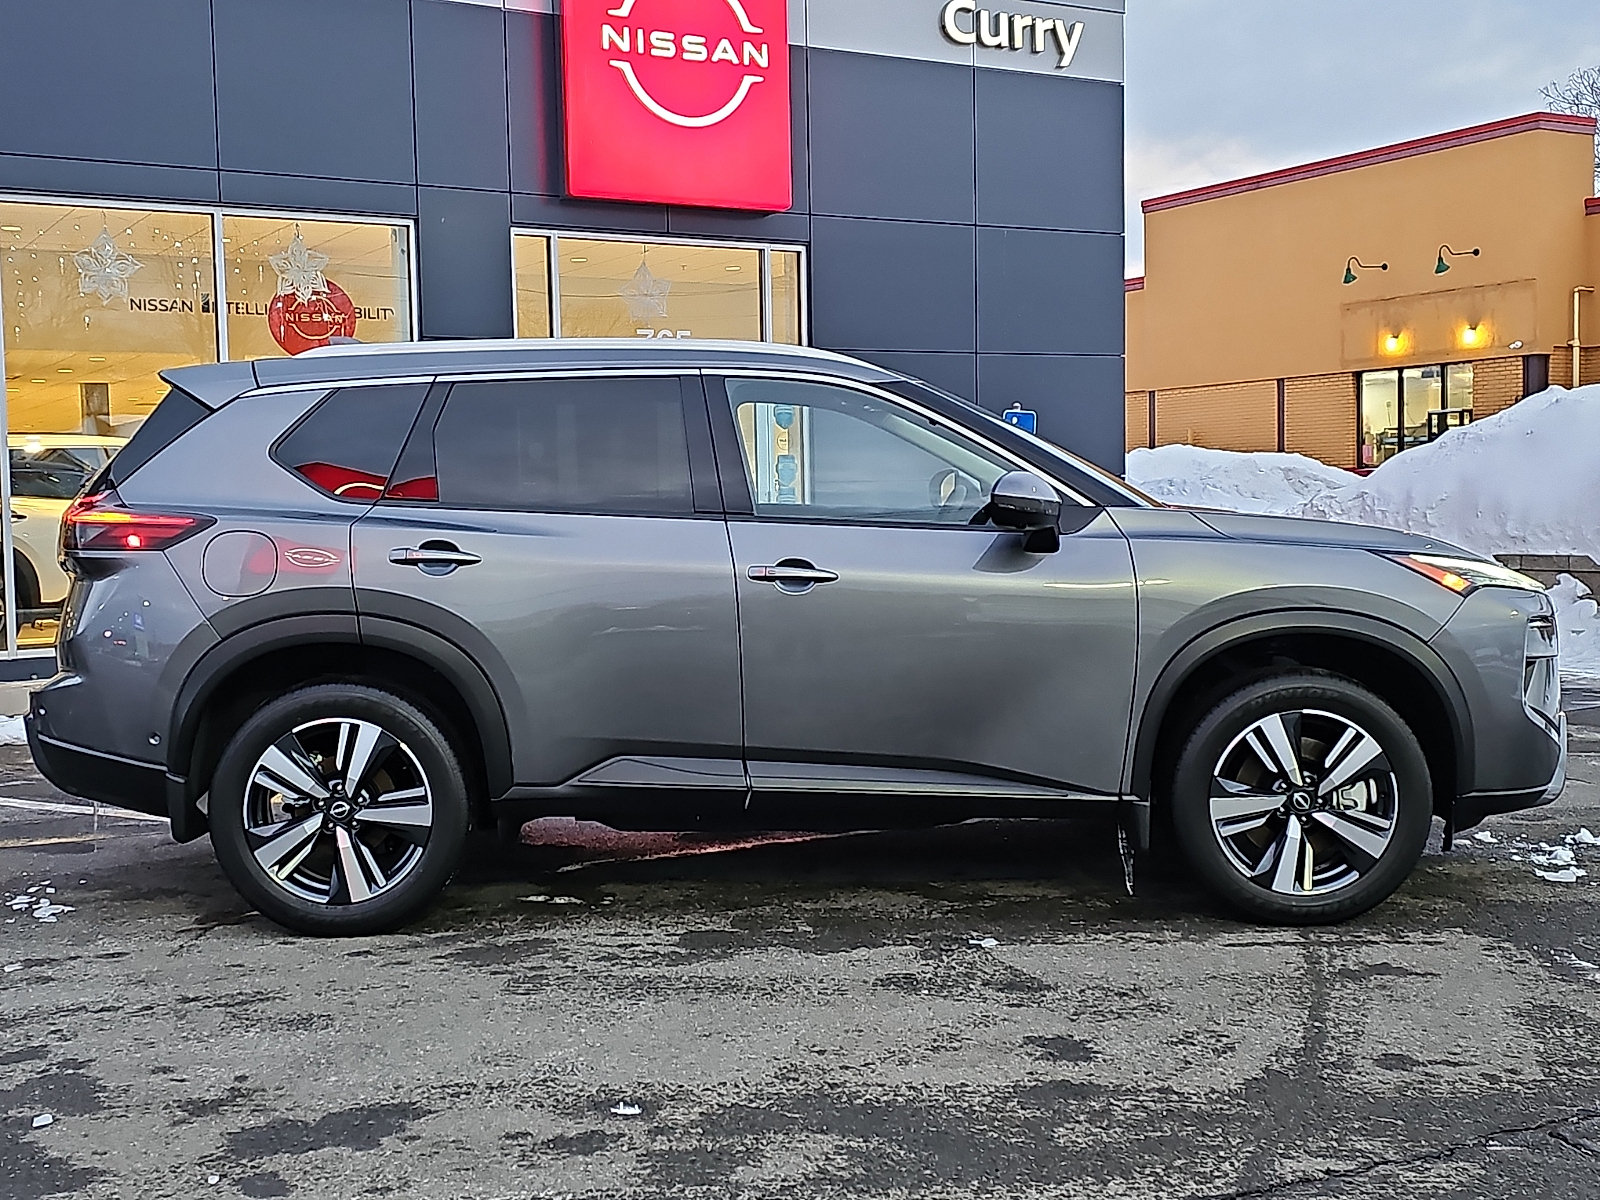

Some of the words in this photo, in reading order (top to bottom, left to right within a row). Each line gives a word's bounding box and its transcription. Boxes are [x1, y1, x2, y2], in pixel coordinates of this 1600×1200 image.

[602, 24, 769, 68] NISSAN
[941, 0, 1085, 67] Curry
[130, 298, 194, 313] NISSAN
